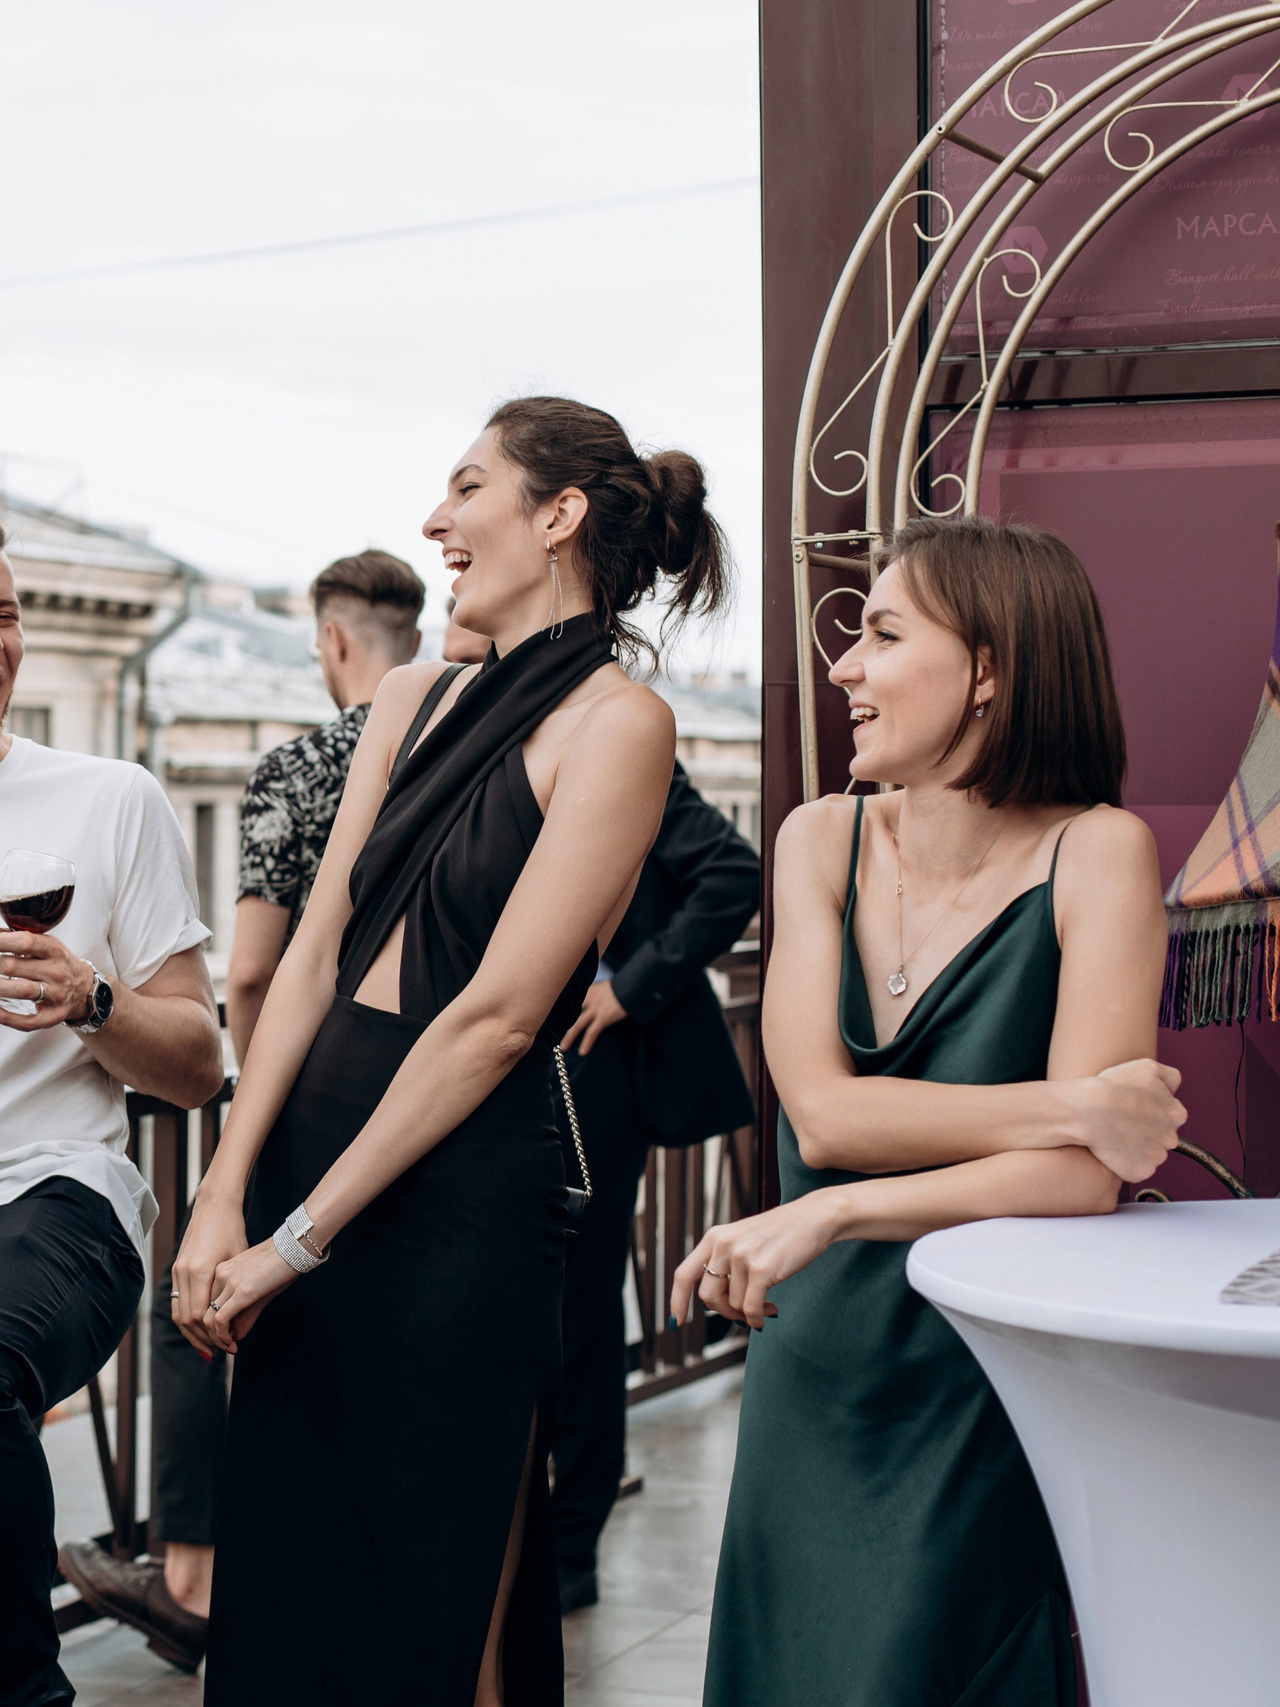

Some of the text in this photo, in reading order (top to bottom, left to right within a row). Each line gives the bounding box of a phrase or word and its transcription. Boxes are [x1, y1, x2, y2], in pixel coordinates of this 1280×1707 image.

[947, 26, 971, 43] We
[975, 23, 1005, 40] make
[1078, 16, 1103, 33] love
[1197, 140, 1229, 159] make
[1233, 143, 1272, 156] events
[1175, 212, 1280, 240] МАРСА
[1164, 263, 1280, 293] Banquet hall with
[1079, 286, 1105, 302] love
